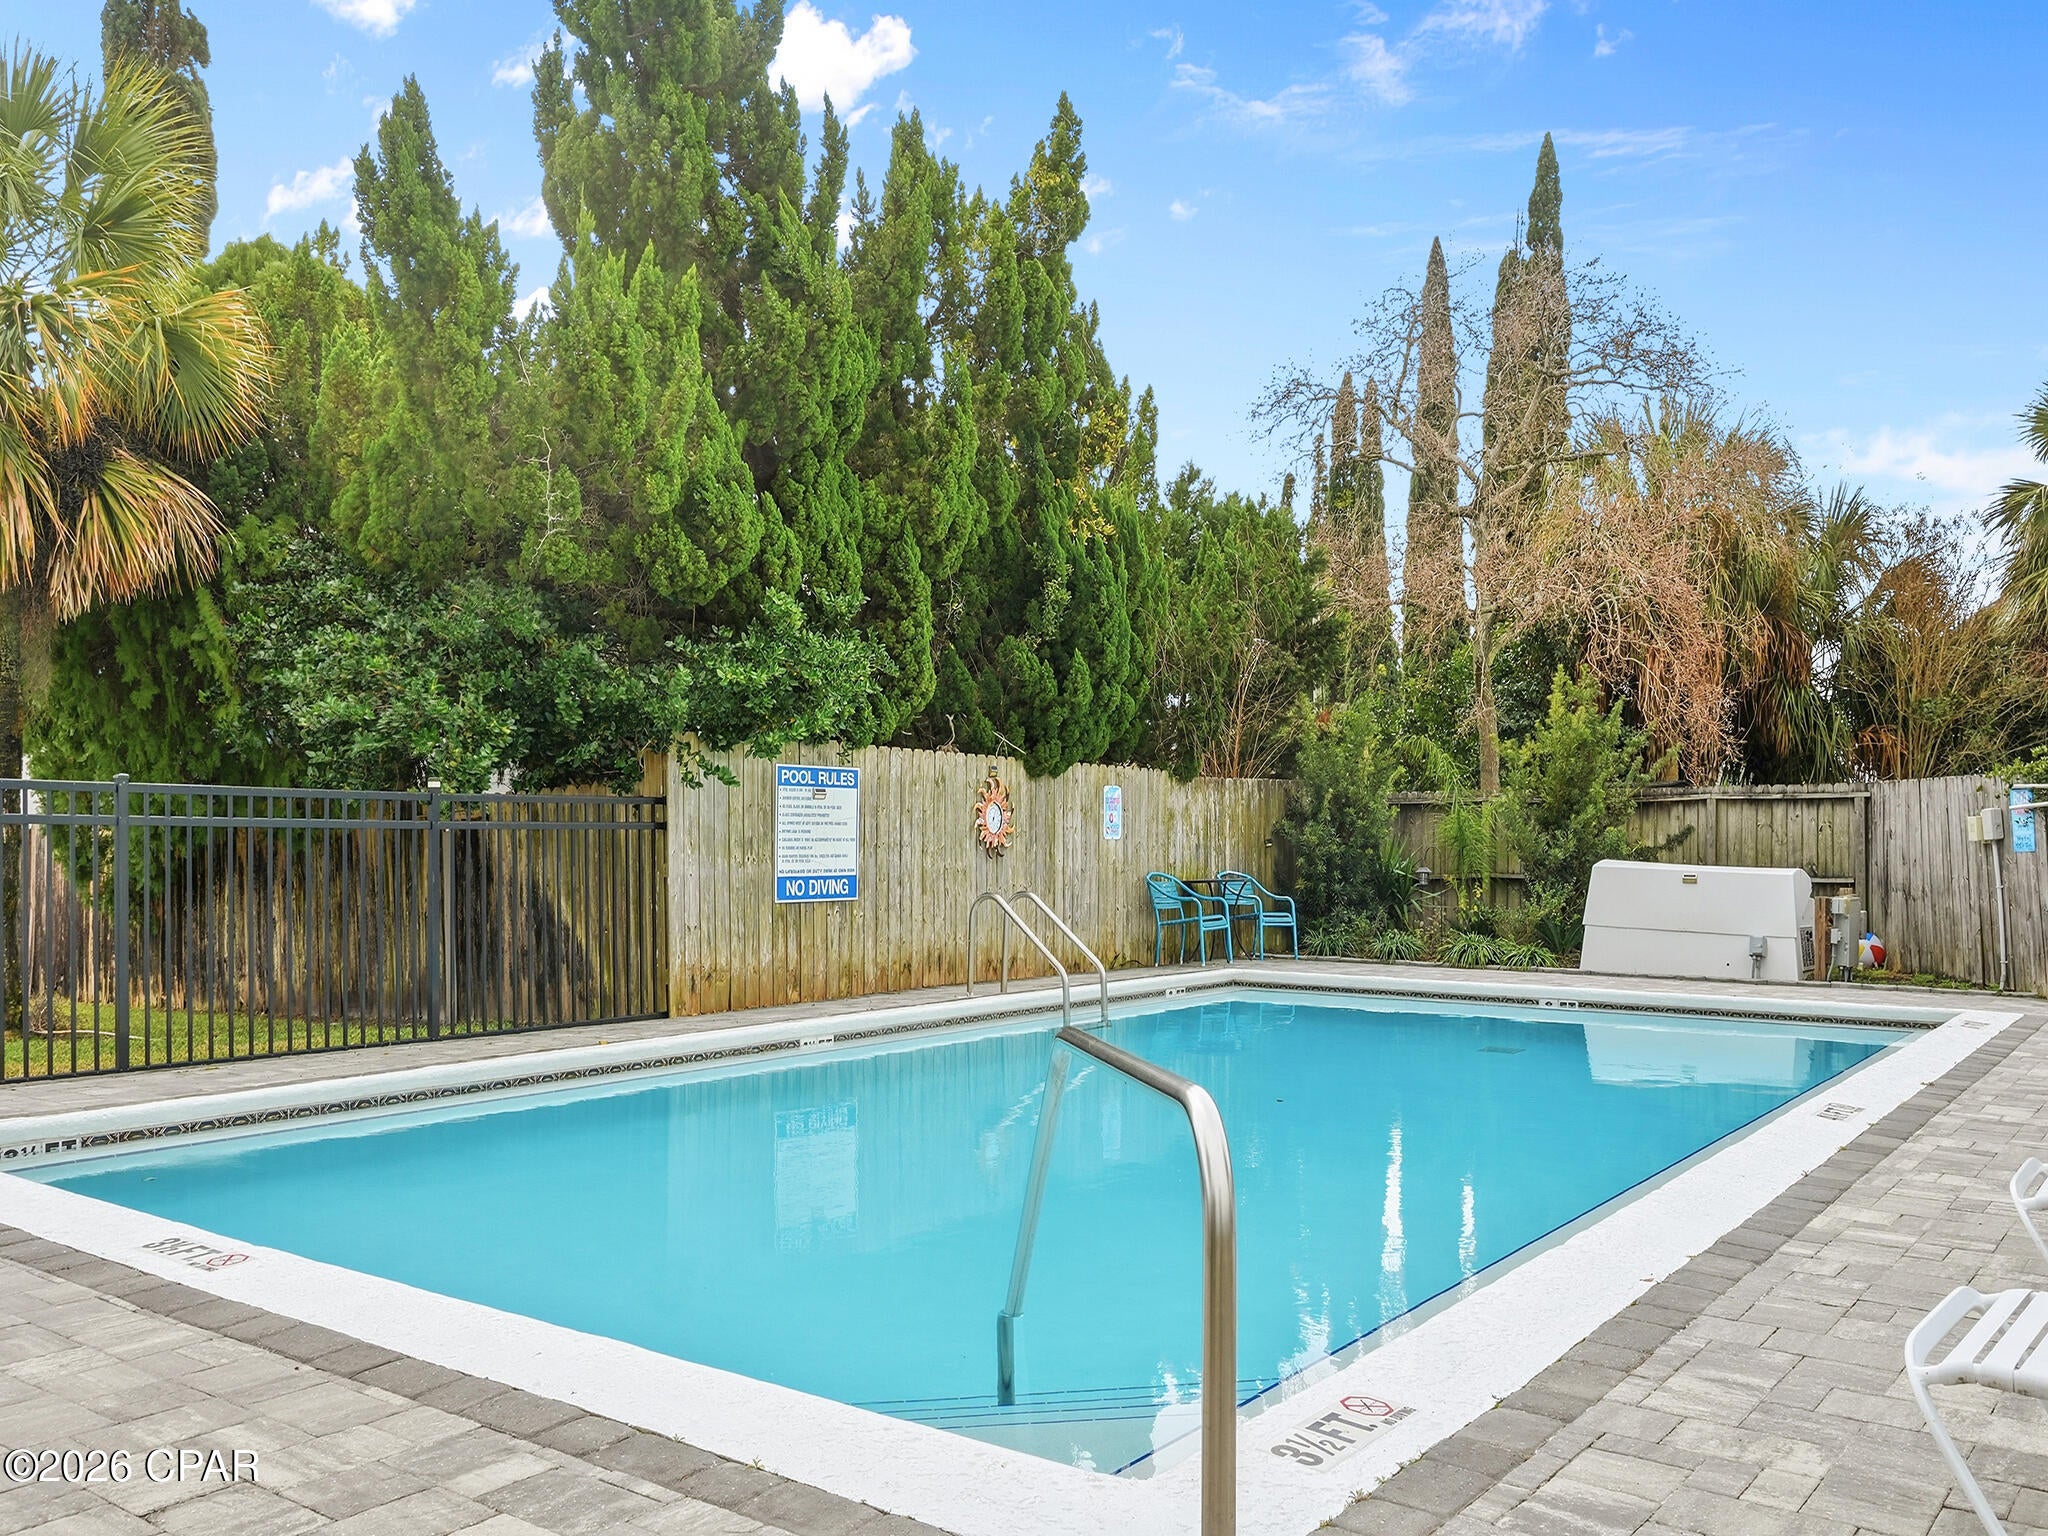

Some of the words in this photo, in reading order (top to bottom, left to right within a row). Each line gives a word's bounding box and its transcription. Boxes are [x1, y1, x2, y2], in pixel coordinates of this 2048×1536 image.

[781, 769, 815, 784] POOL
[818, 771, 855, 786] RULES
[786, 879, 805, 896] NO
[808, 878, 849, 896] DIVING
